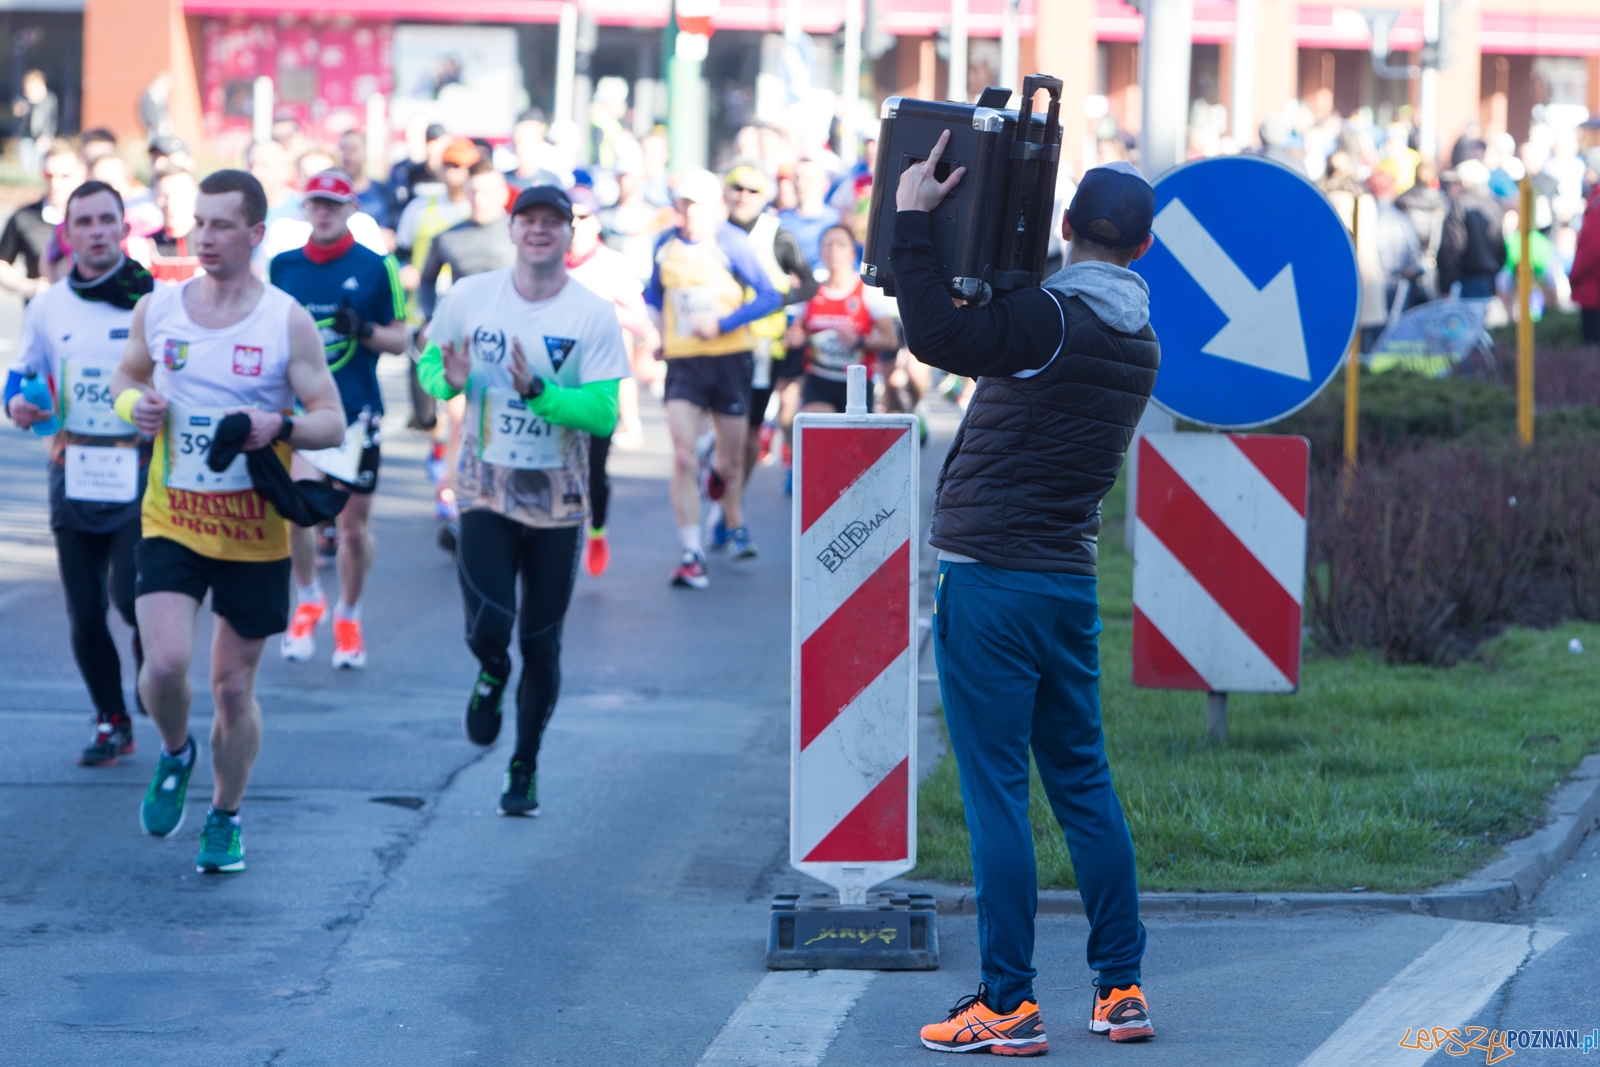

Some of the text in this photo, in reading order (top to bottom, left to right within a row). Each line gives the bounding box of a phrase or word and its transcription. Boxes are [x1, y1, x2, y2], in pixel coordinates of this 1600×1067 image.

[73, 382, 114, 403] 956
[499, 413, 552, 437] 3741
[180, 433, 211, 456] 39
